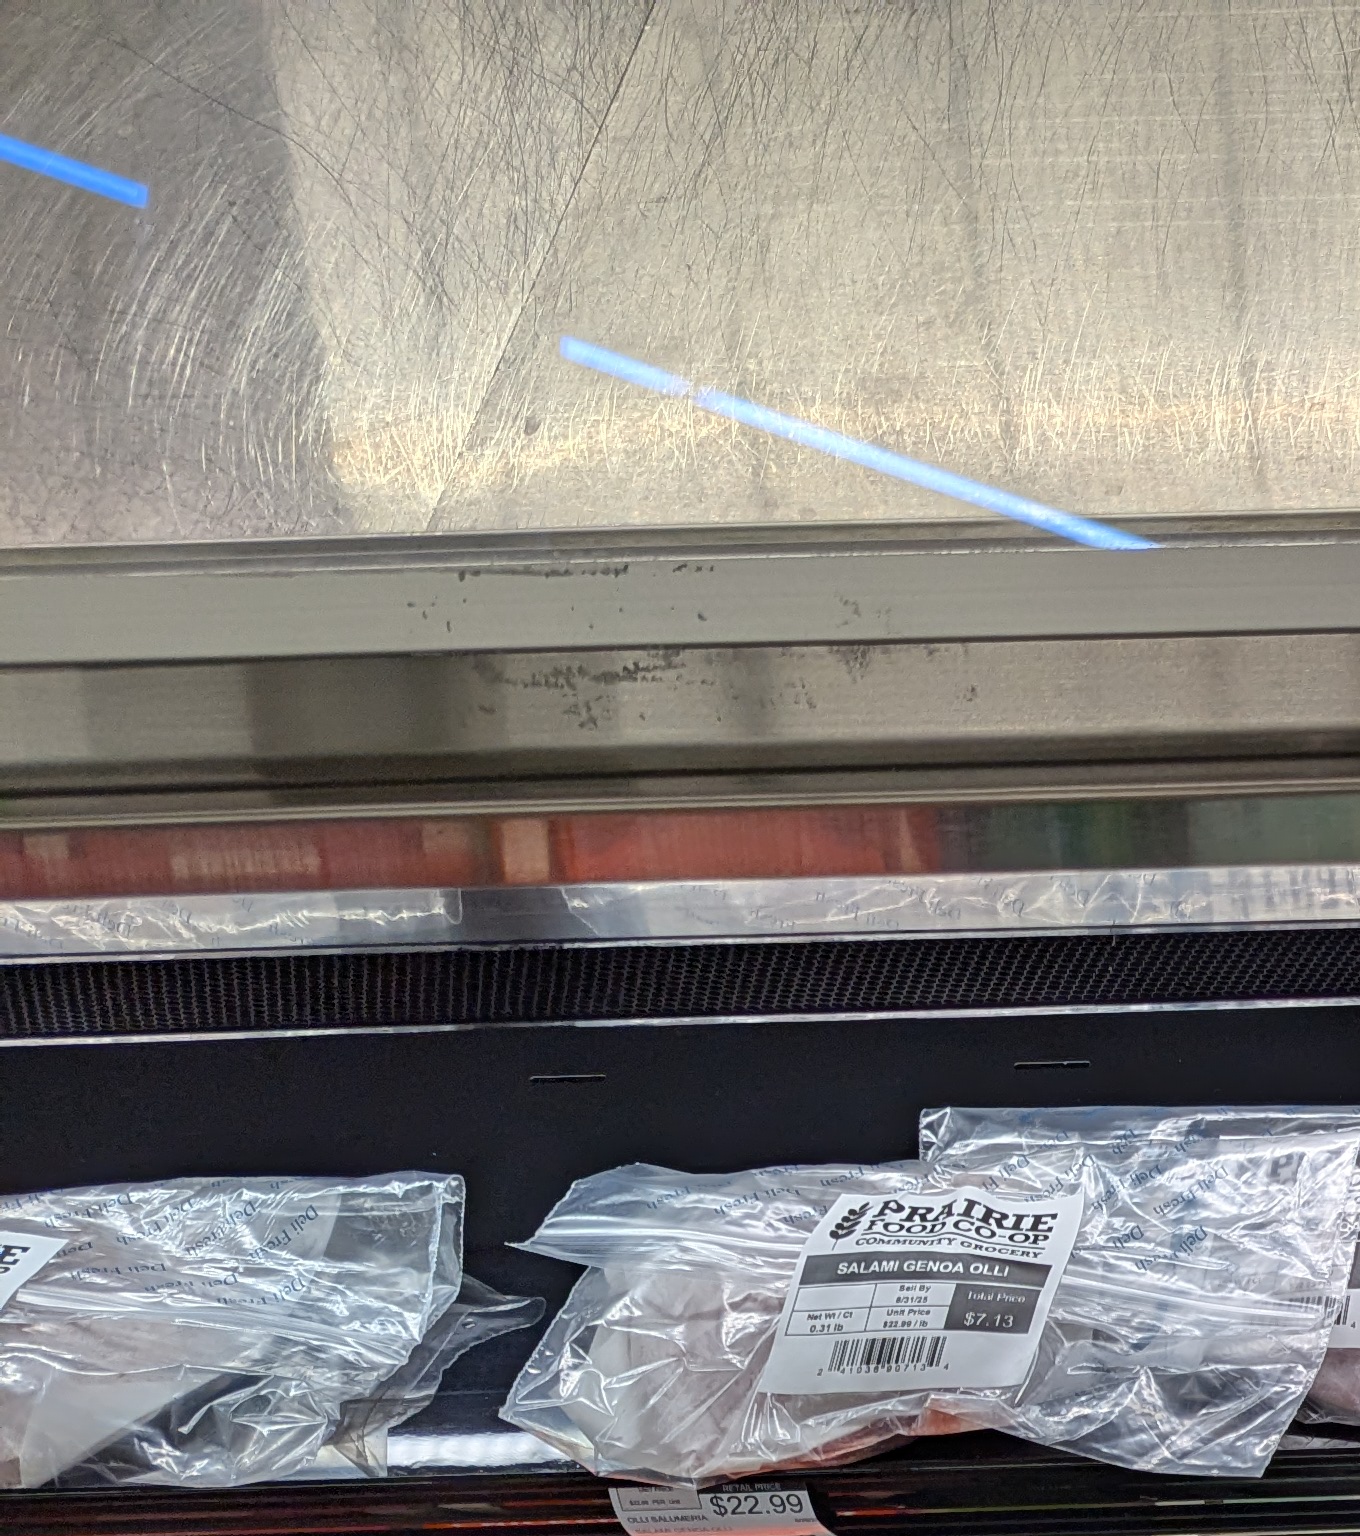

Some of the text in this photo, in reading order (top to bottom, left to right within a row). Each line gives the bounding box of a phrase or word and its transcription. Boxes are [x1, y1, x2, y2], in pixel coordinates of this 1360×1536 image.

[873, 1198, 1059, 1232] PRAIRIE
[862, 1219, 1050, 1245] FOOD CO-OP
[855, 1237, 1042, 1259] COMMUNITY GROCERY
[837, 1261, 1008, 1277] SALAMI GENOA OLLI
[967, 1291, 1025, 1303] Total Price
[810, 1324, 843, 1332] 0.31 lb
[964, 1311, 1014, 1328] $7.13
[710, 1493, 804, 1517] $22.99
